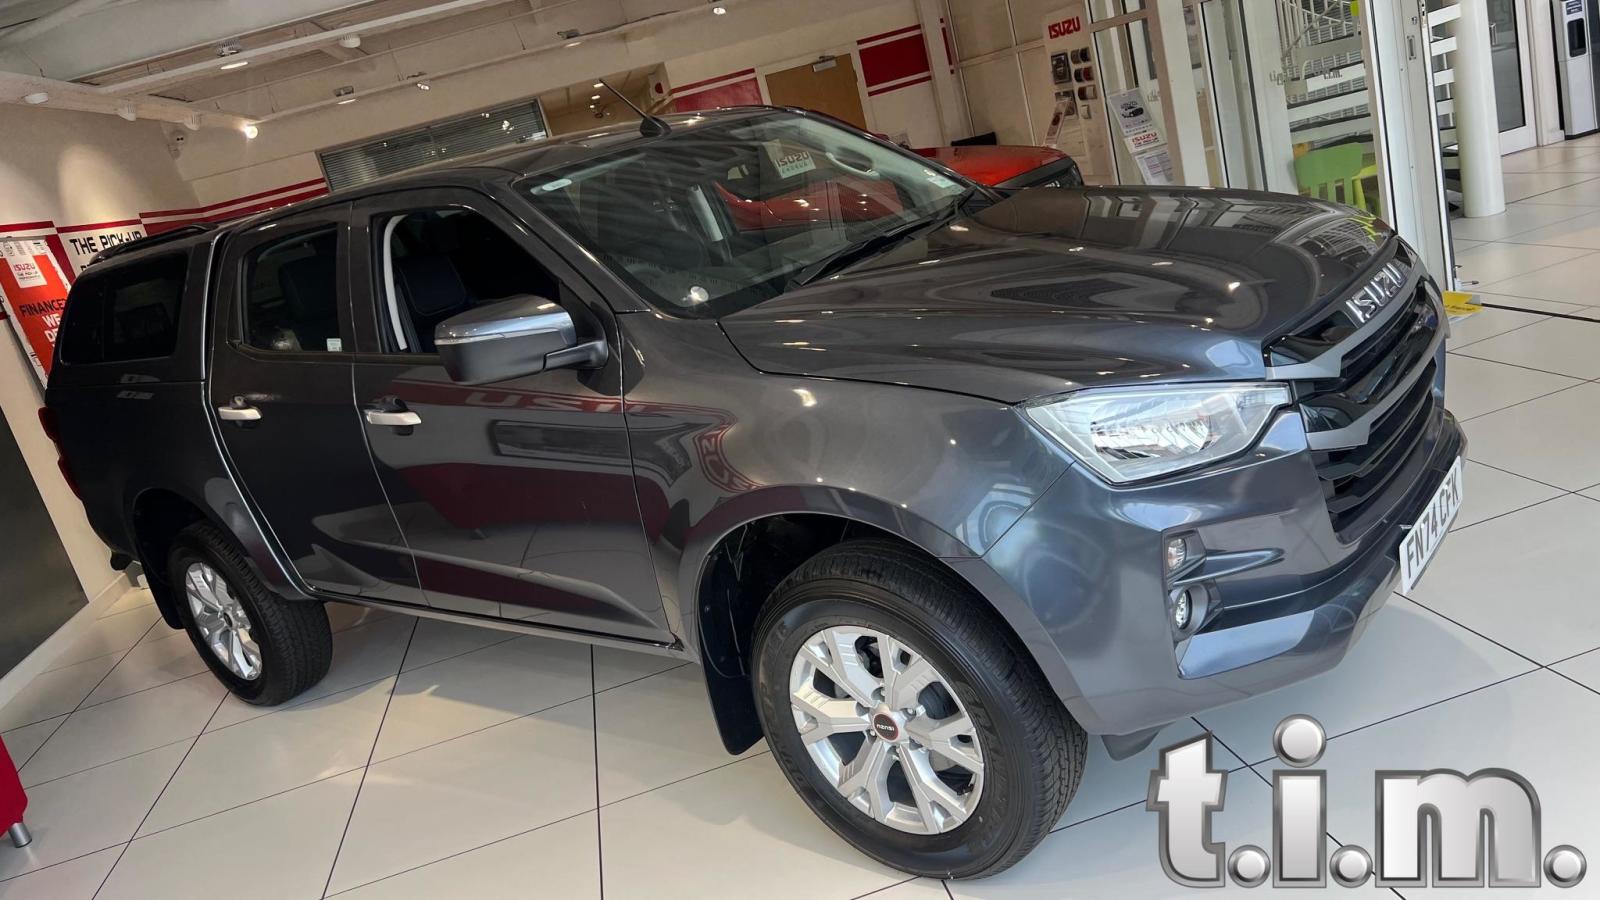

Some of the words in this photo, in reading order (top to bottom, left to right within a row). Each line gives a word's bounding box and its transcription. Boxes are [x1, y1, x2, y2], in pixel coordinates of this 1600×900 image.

[1048, 15, 1081, 39] ISUZU
[775, 151, 810, 168] ISUZU
[69, 236, 98, 256] THE
[1345, 262, 1402, 323] ISUZU
[1406, 502, 1438, 580] FN74
